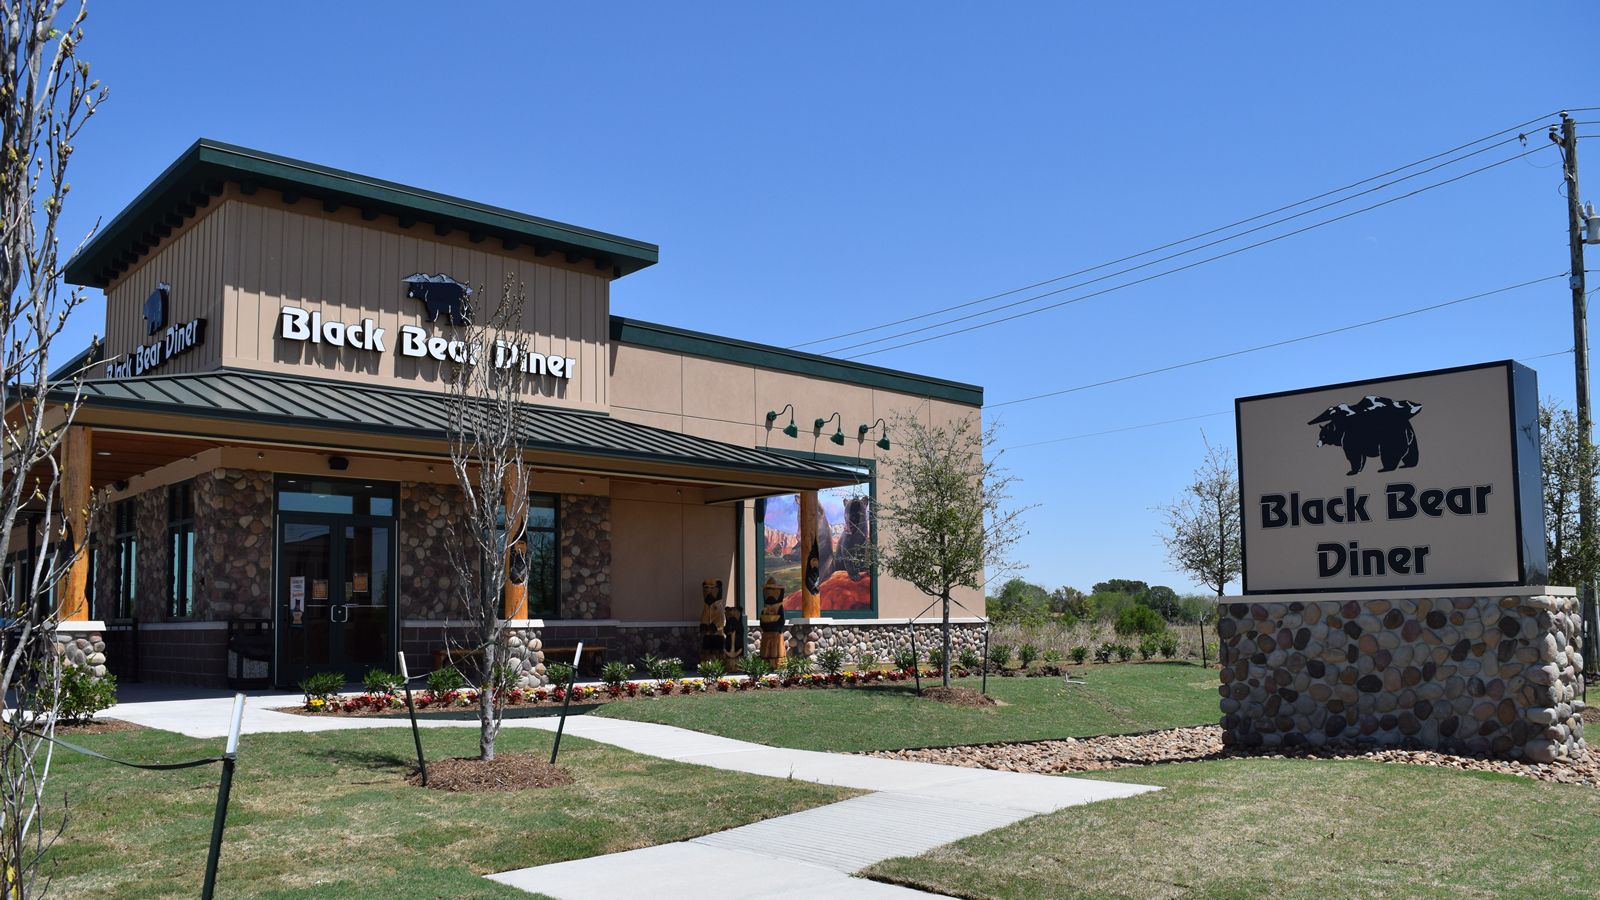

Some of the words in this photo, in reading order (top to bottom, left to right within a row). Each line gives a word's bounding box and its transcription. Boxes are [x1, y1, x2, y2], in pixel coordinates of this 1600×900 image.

[136, 344, 162, 376] Bear
[165, 319, 199, 360] Diner
[281, 305, 386, 353] Black
[400, 324, 483, 367] Bear
[494, 338, 577, 380] Diner
[1260, 487, 1372, 529] Black
[1386, 483, 1493, 520] Bear
[1316, 541, 1431, 578] Diner
